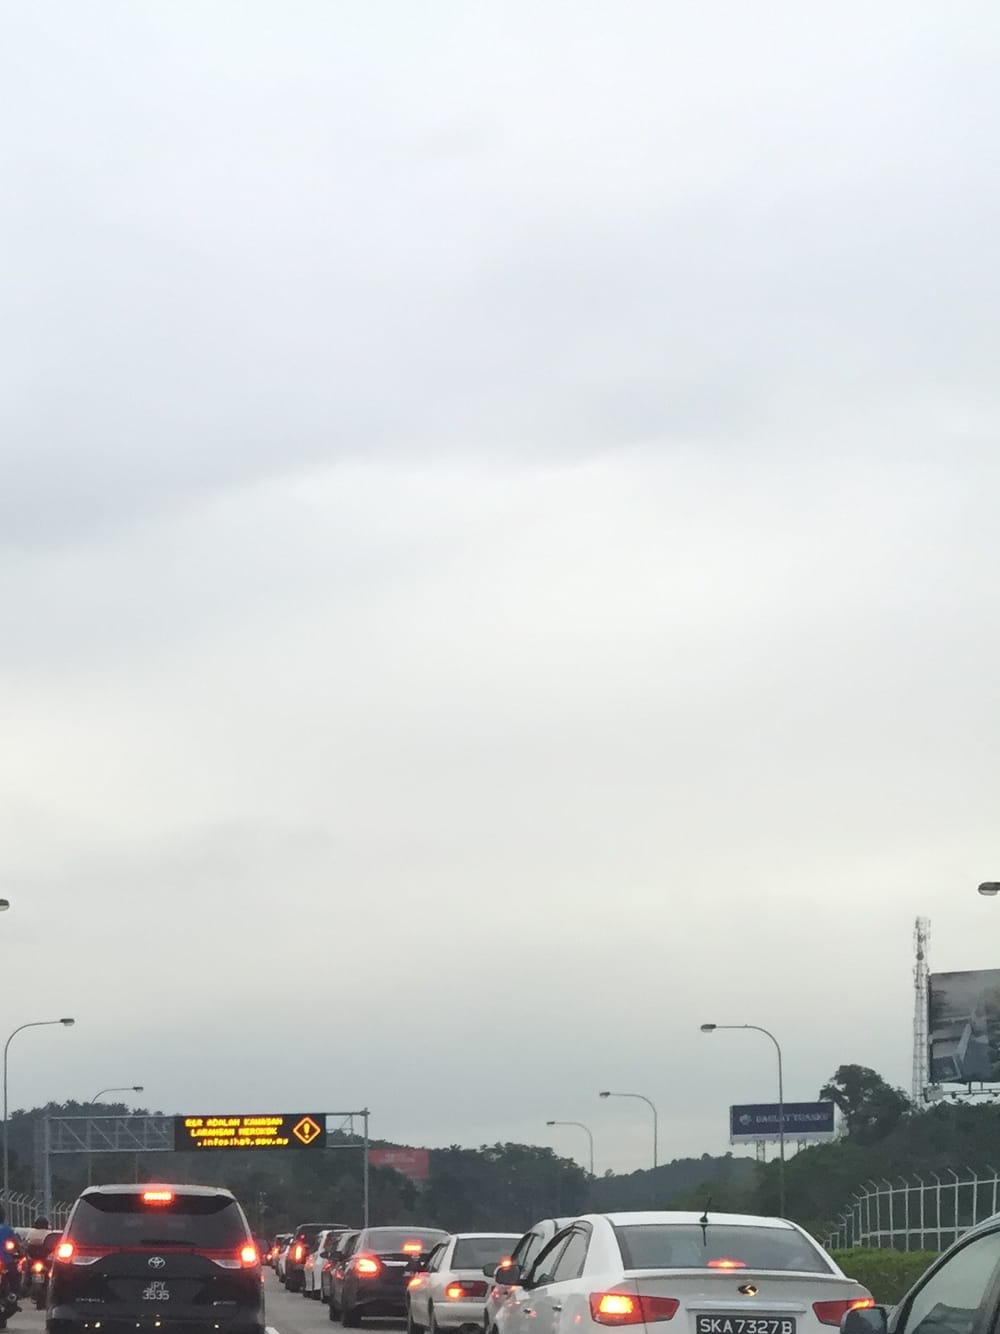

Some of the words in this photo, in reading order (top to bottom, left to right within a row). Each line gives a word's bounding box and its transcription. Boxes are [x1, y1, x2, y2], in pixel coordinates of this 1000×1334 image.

[206, 1118, 241, 1127] ADALAH
[238, 1127, 278, 1136] MEROKOK
[142, 1289, 170, 1300] 3535
